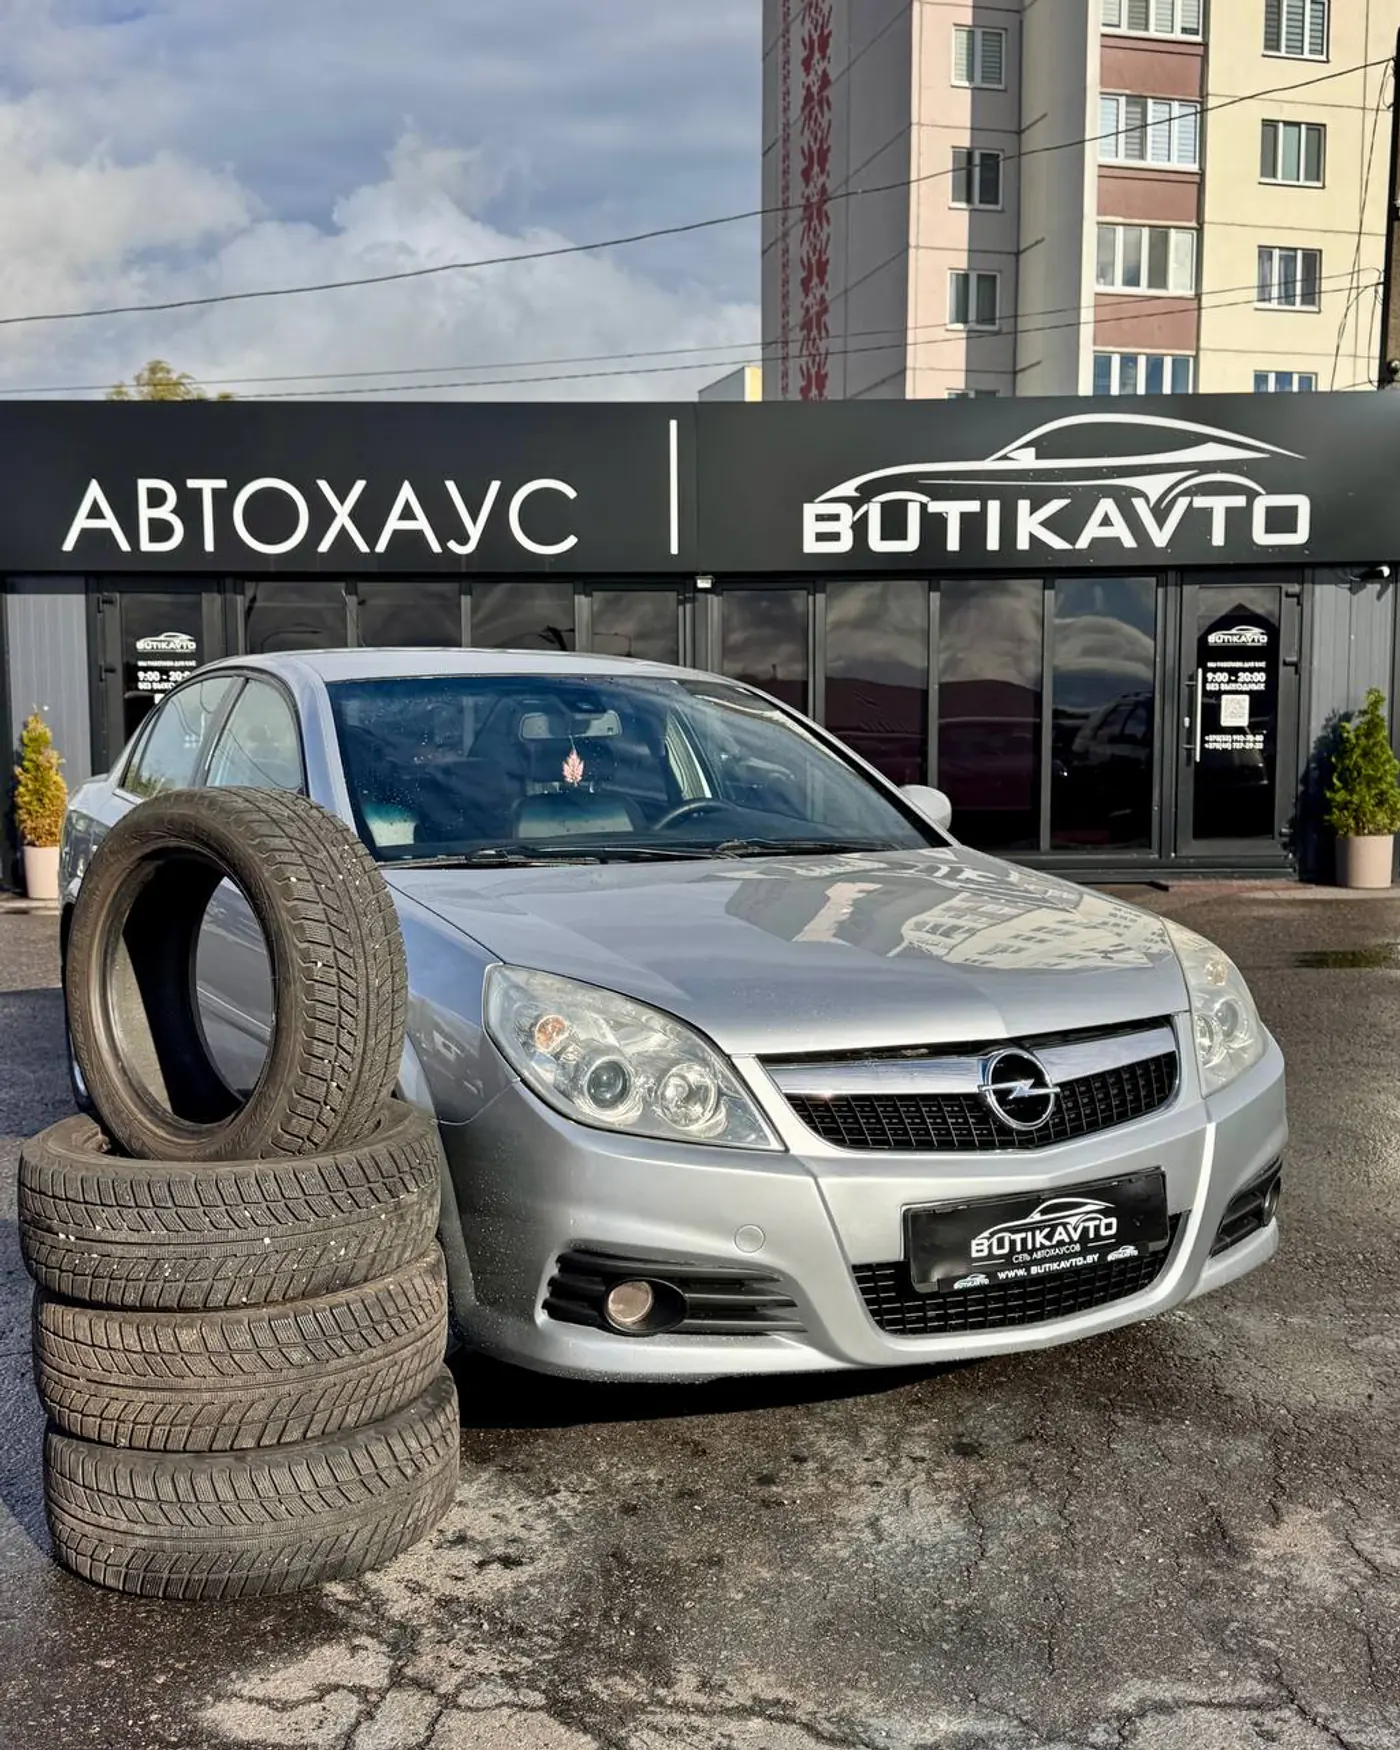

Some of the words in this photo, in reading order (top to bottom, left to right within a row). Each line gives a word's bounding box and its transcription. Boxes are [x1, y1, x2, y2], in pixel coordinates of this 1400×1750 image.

[61, 477, 579, 555] АВТОХАУС
[803, 494, 1311, 555] BUTIKAVTO
[1206, 672, 1229, 682] 9:00
[1237, 672, 1266, 682] 20:00
[971, 1216, 1118, 1258] BUTIKAVTO
[1032, 1243, 1081, 1260] АВТОХАУСОВ
